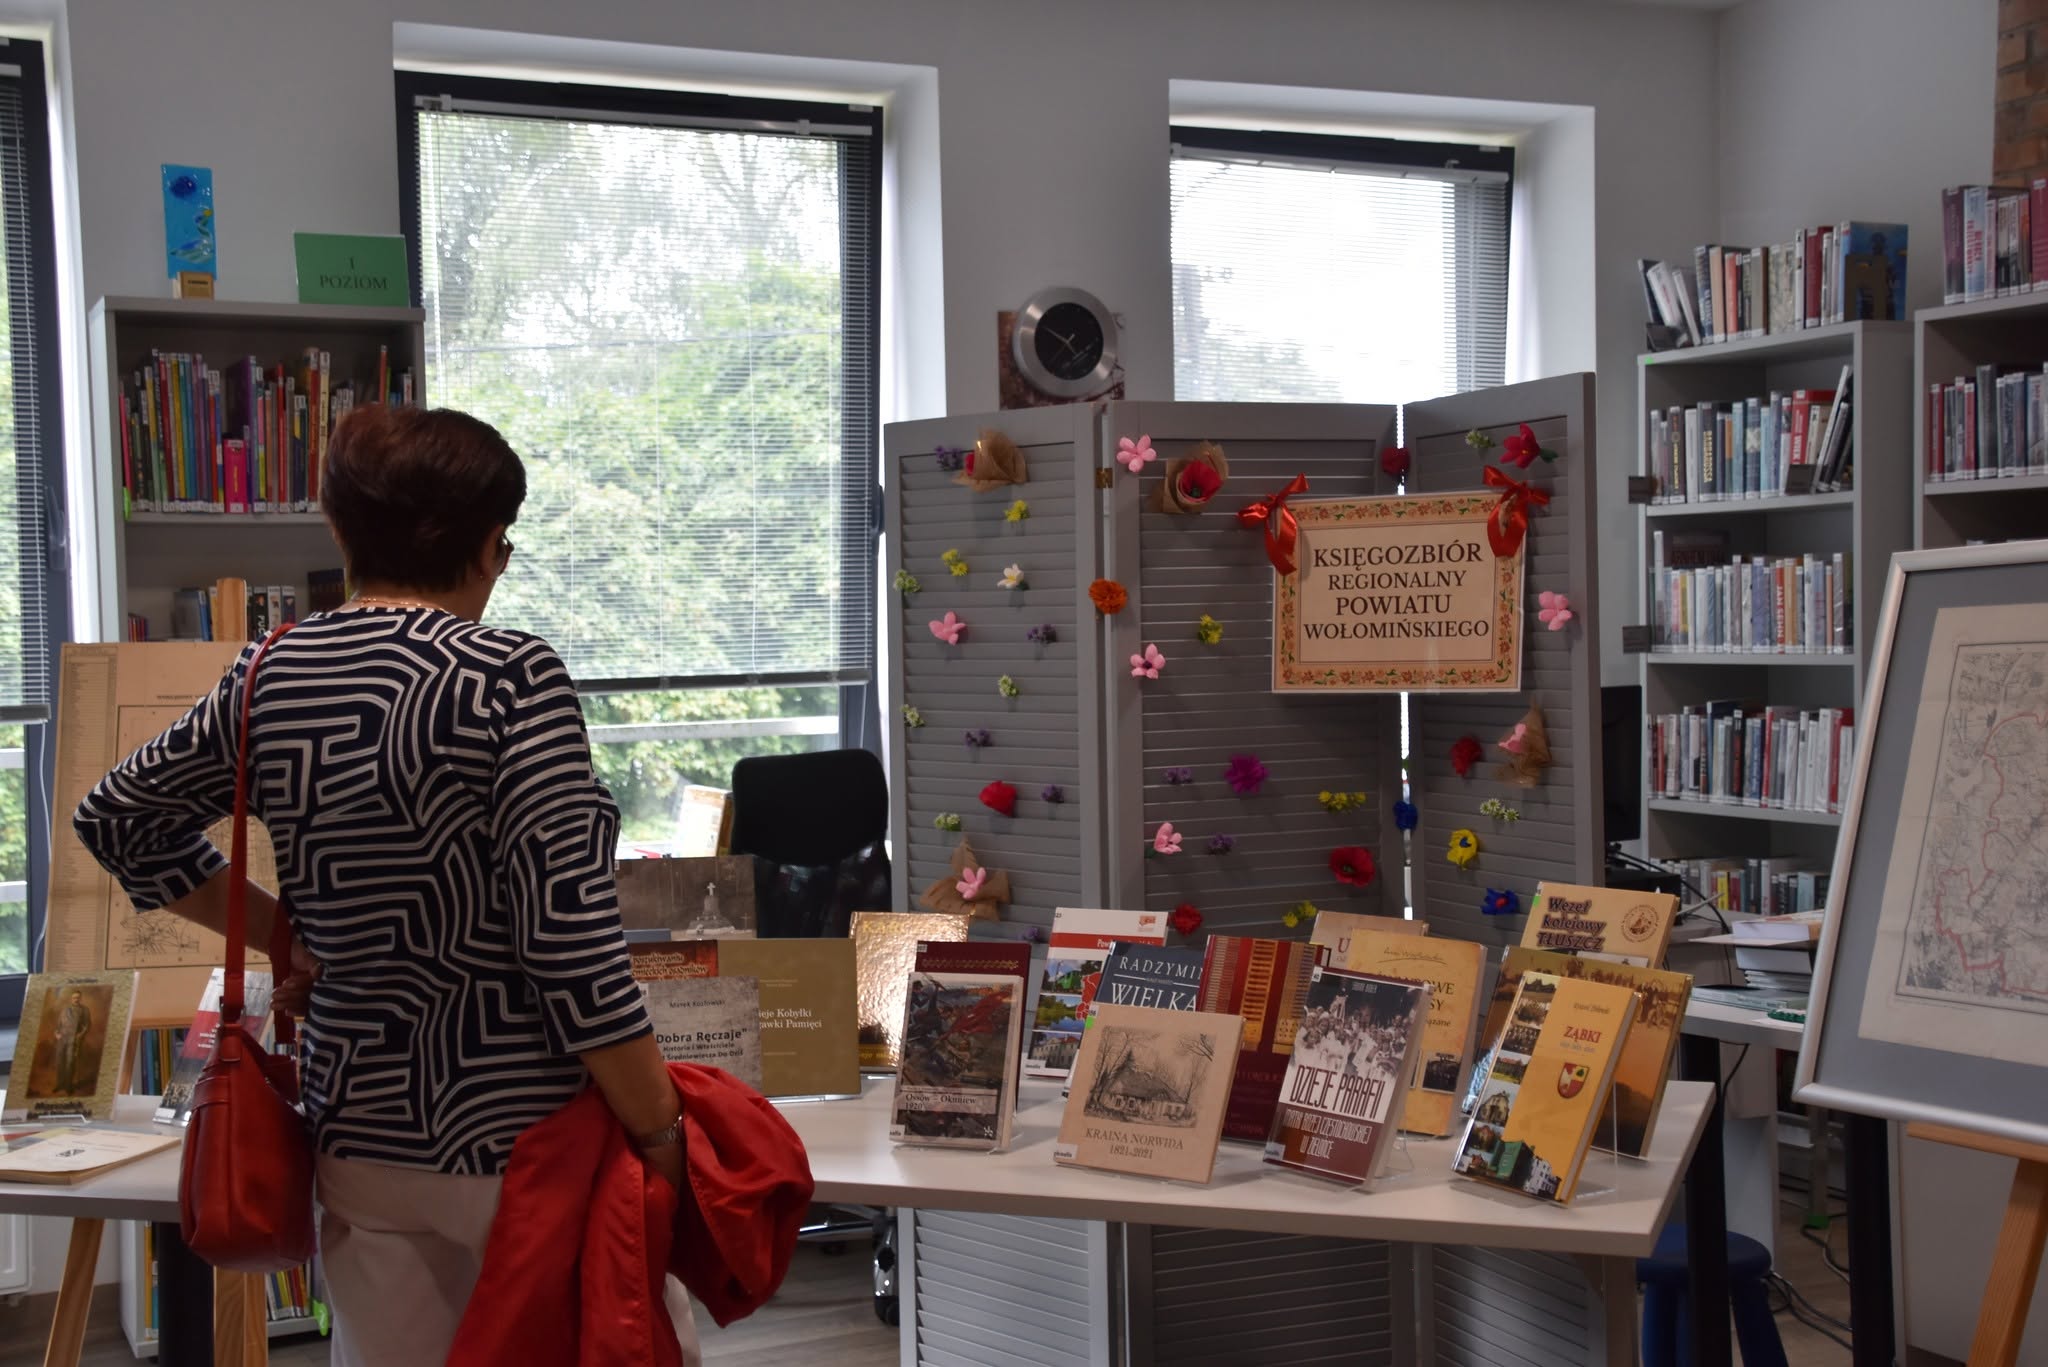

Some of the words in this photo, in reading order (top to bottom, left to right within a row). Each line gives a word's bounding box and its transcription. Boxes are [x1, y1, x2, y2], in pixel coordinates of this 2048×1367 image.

[319, 275, 388, 290] POZIOM
[1313, 539, 1482, 569] KSIĘGOZBIÓR
[1328, 570, 1467, 591] REGIONALNY
[1335, 594, 1452, 616] POWIATU
[1303, 617, 1489, 641] WOŁOMIŃSKIEGO
[1541, 913, 1608, 936] kolejowy
[1536, 931, 1606, 952] TŁUSZCZ
[758, 1009, 774, 1020] ieje
[777, 1008, 812, 1020] Kobyłki
[786, 1019, 822, 1031] Pamięci
[1563, 1026, 1602, 1044] ZĄBKI
[656, 1032, 692, 1044] Dobra
[1289, 1064, 1338, 1110] DZIEJE
[1332, 1072, 1386, 1120] PARAFII
[1084, 1127, 1129, 1144] KRAINA
[1129, 1132, 1185, 1151] NORWIDA
[1108, 1144, 1154, 1160] 1821-2021
